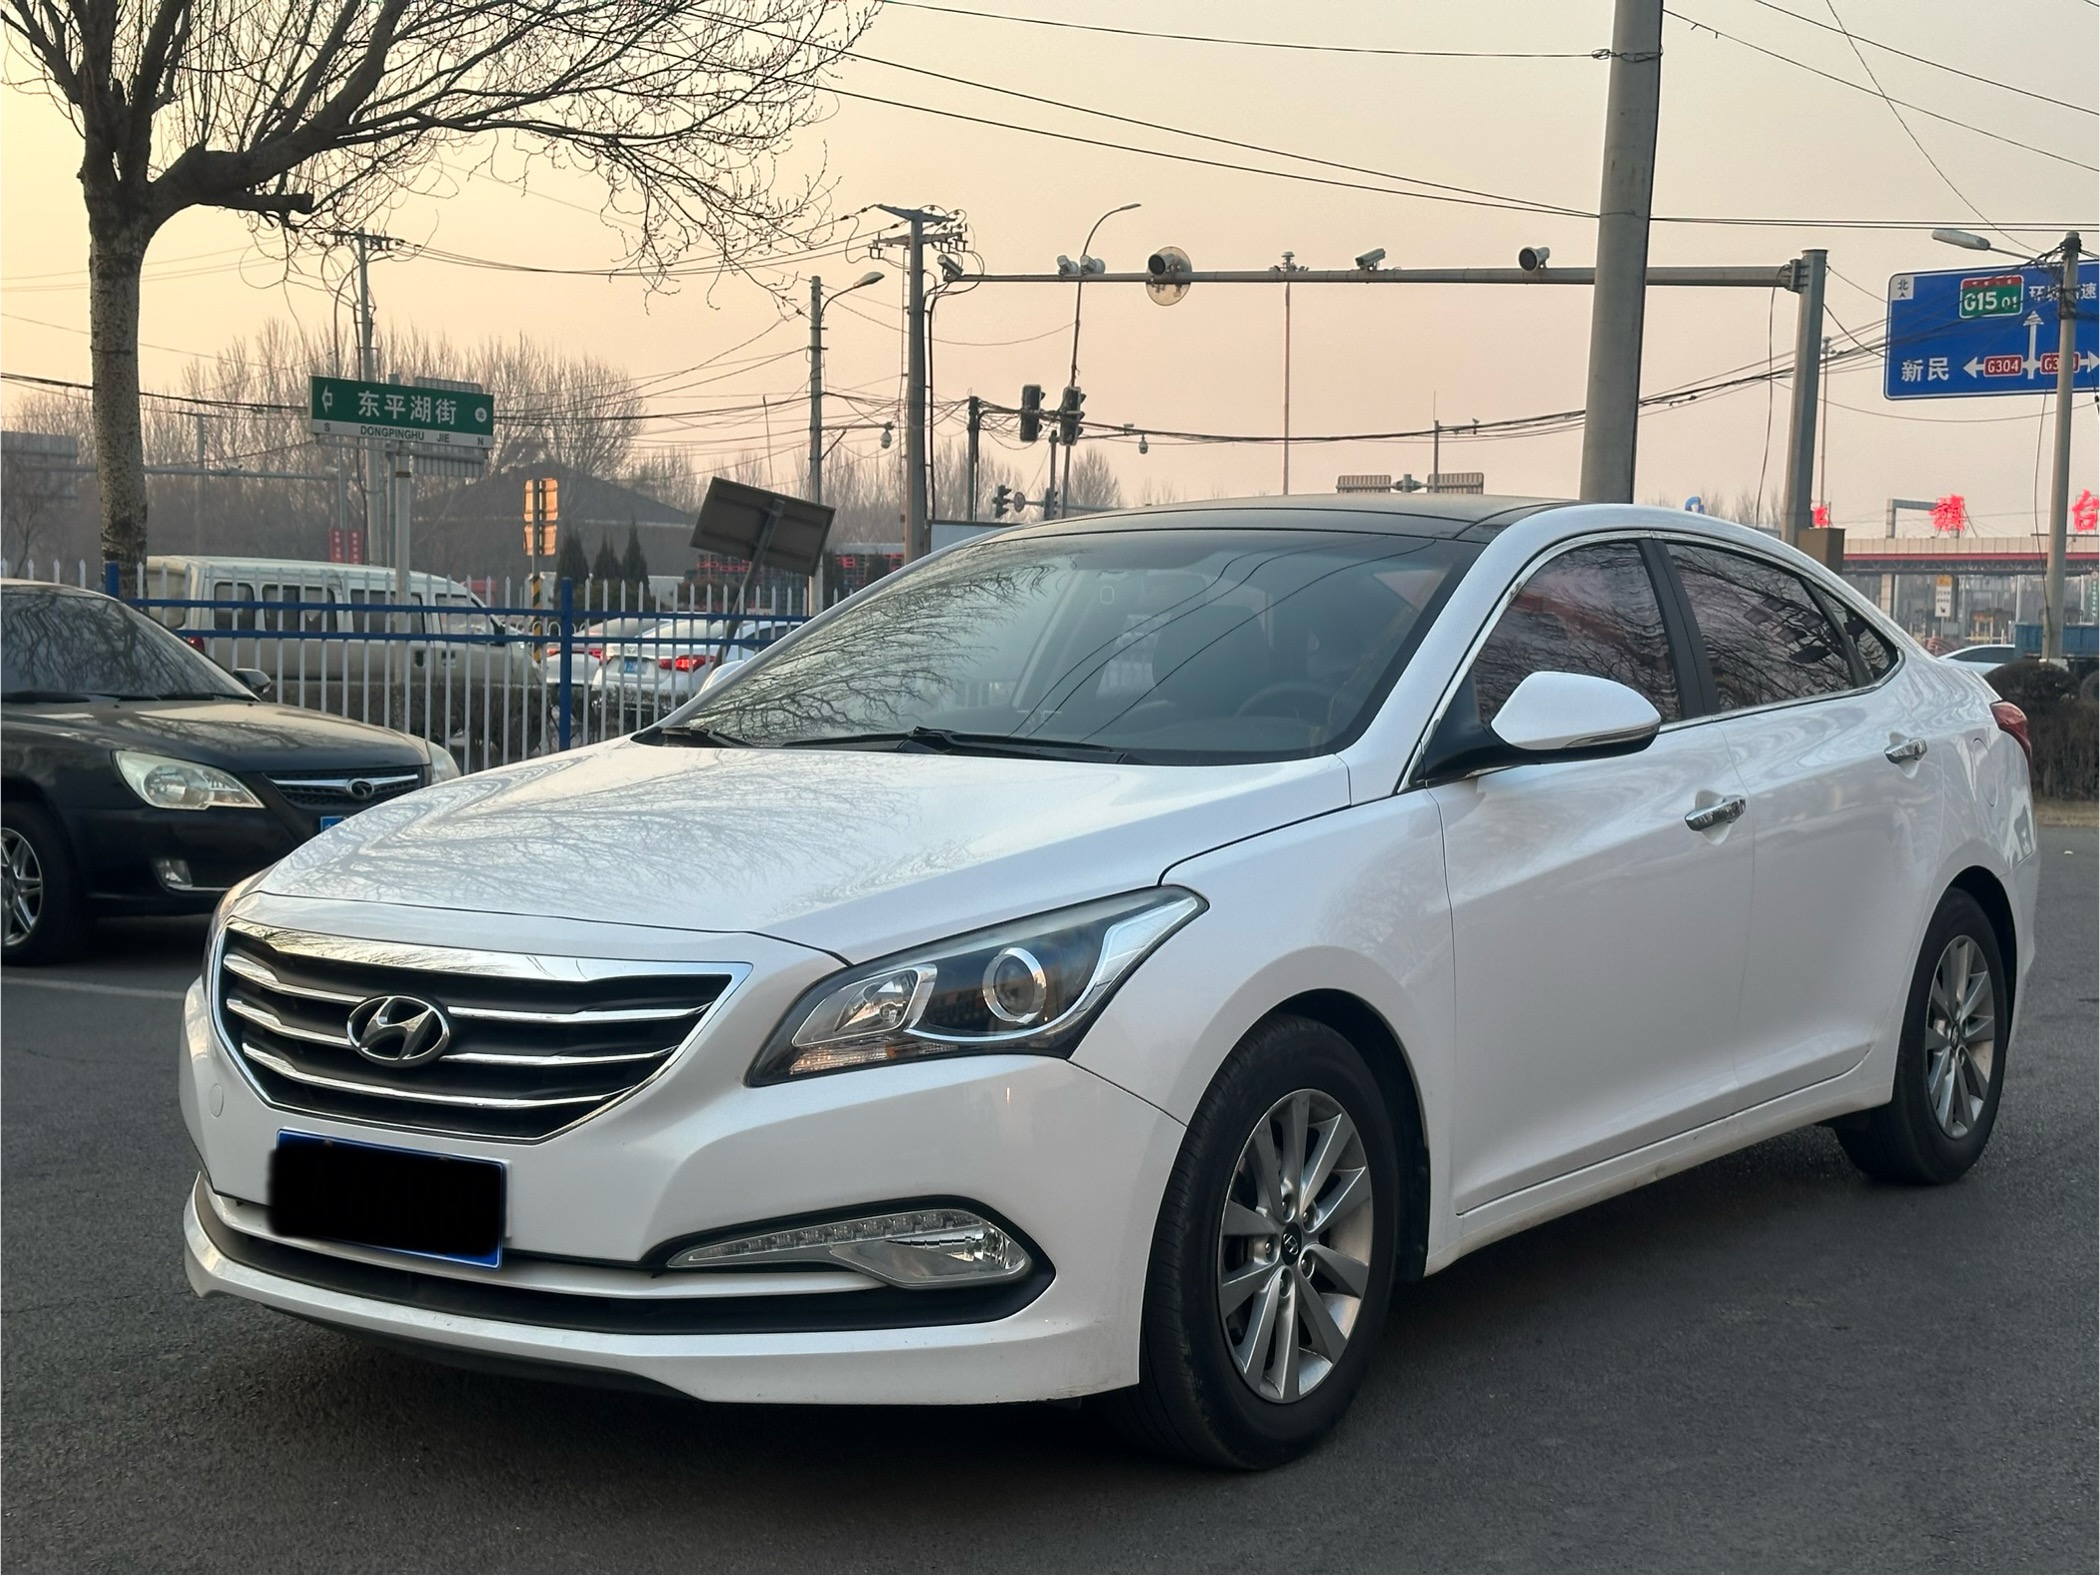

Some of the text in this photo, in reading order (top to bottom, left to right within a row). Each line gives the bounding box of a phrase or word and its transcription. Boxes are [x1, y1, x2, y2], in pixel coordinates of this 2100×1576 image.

[1897, 279, 1909, 292] 北
[1901, 357, 1950, 382] 新民
[1987, 359, 2019, 374] G304
[358, 390, 457, 425] 东平湖街
[323, 422, 484, 446] S DONGPINGHU JIE N
